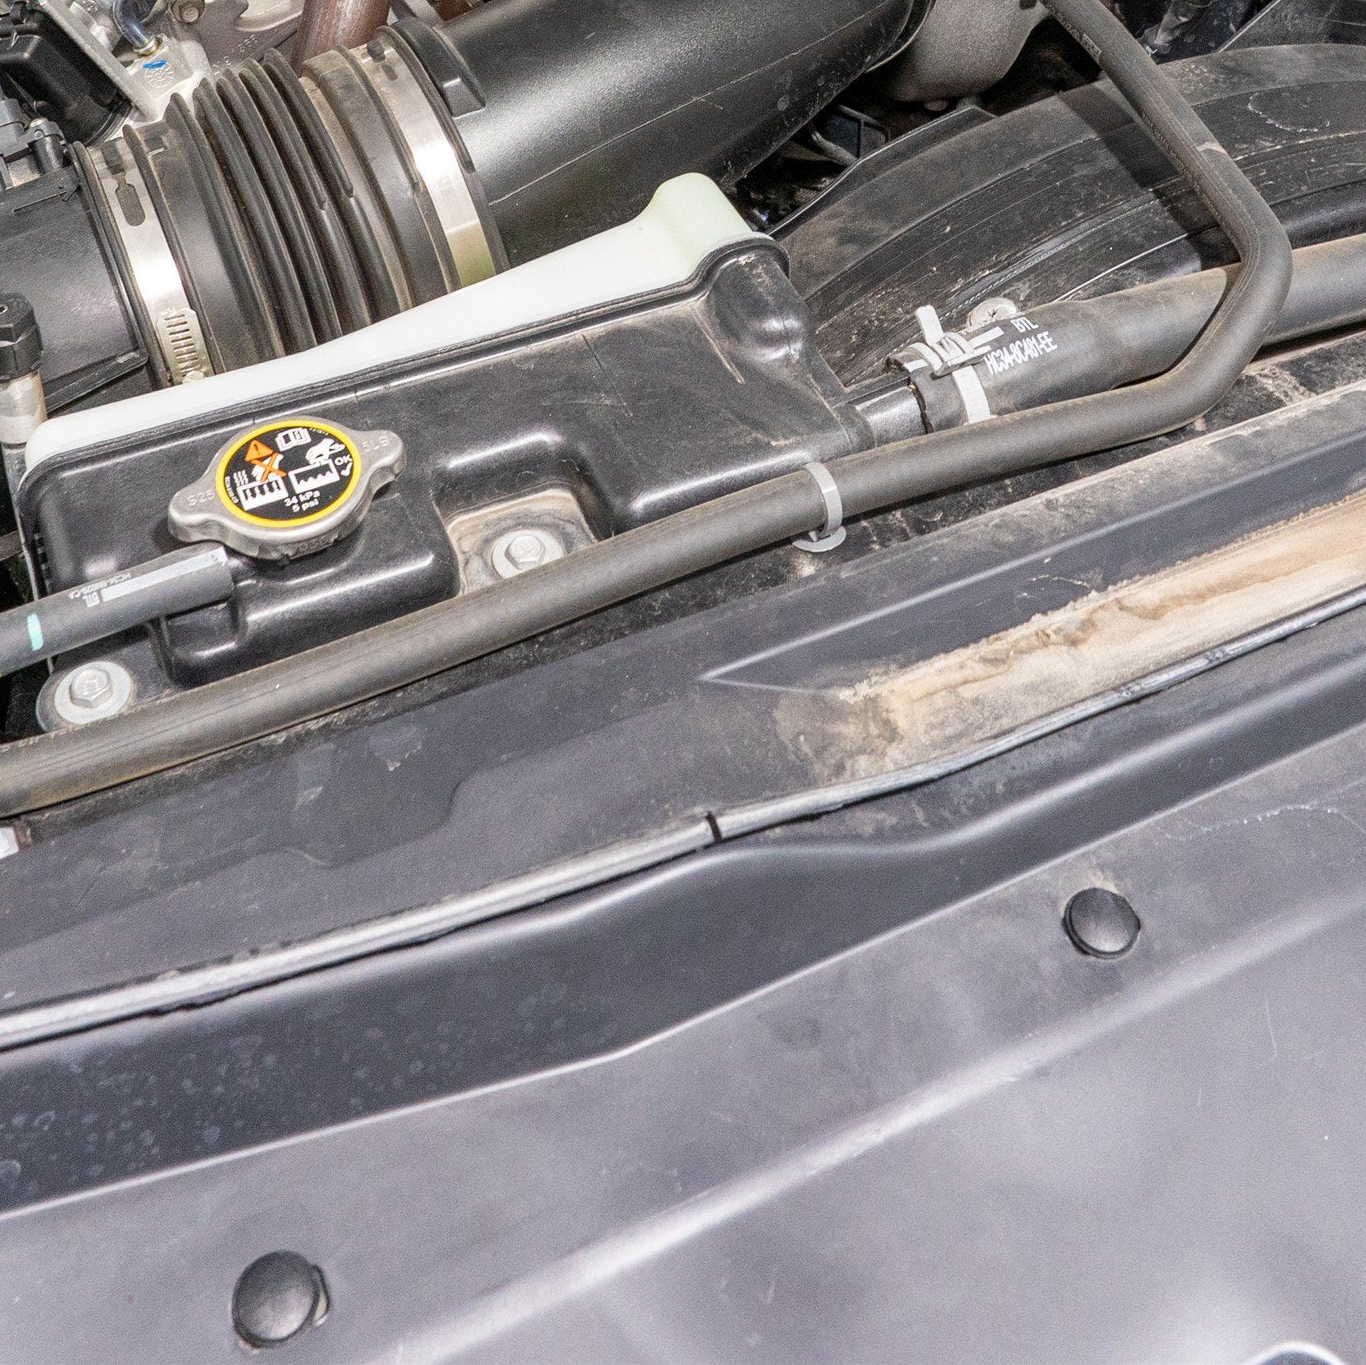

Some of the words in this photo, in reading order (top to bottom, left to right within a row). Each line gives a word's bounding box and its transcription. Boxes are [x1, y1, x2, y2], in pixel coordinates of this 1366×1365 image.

[1010, 316, 1039, 333] BTL
[334, 454, 352, 466] OK
[298, 490, 321, 503] kPa
[302, 499, 319, 511] psi
